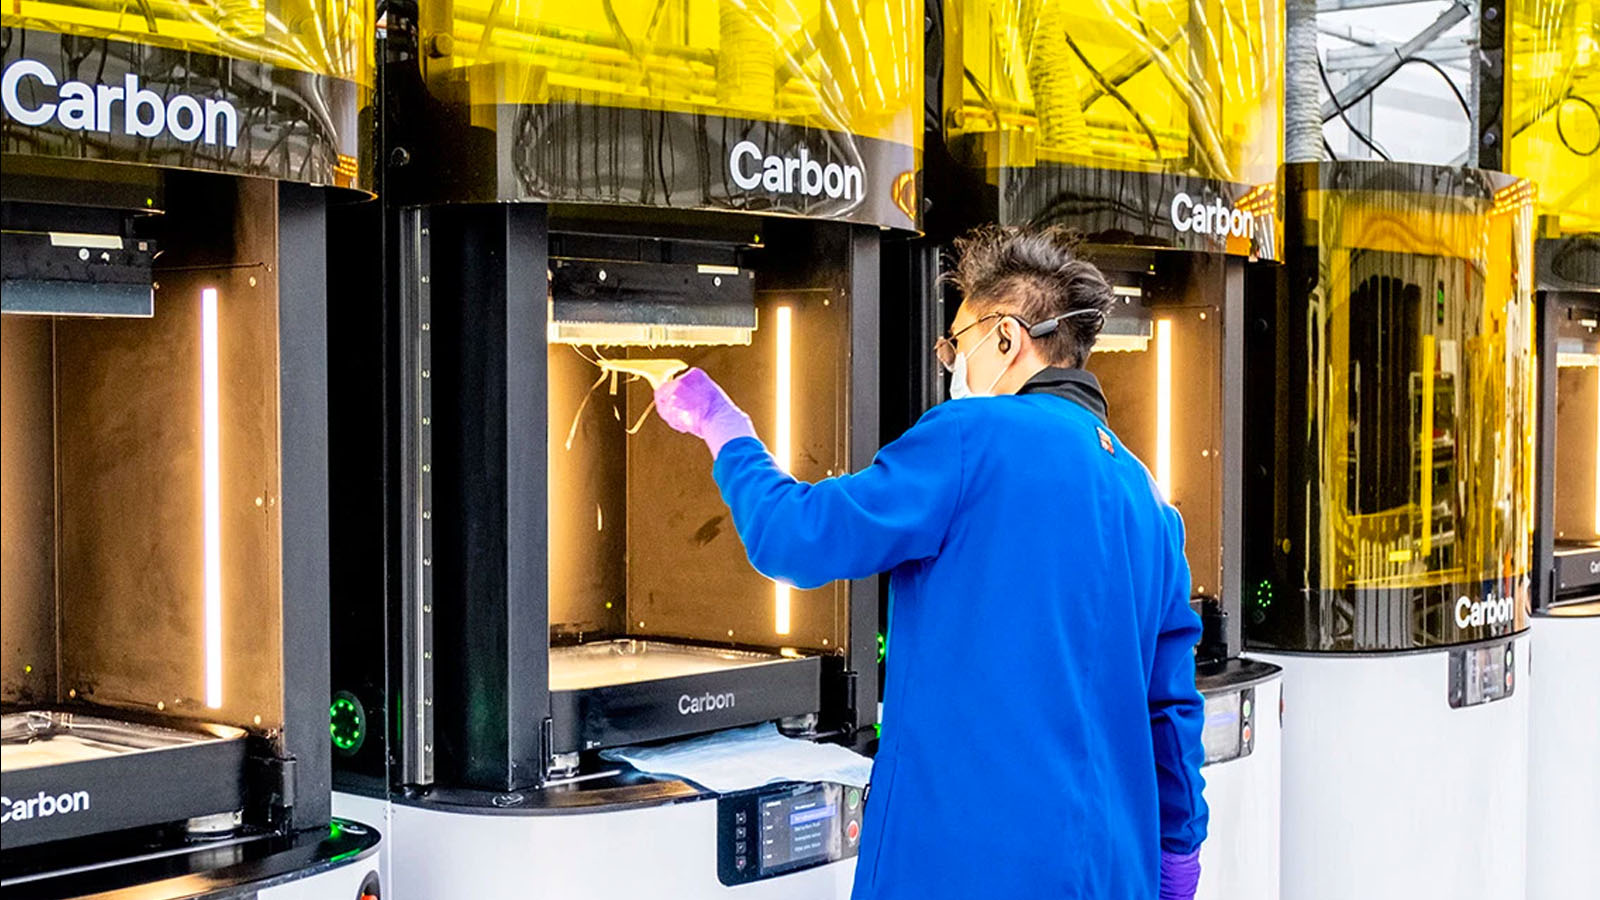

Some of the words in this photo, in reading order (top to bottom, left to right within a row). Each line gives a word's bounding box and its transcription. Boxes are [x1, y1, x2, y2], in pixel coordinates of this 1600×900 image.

[1, 59, 237, 147] Carbon
[730, 141, 863, 201] Carbon
[1171, 192, 1254, 239] Carbon
[1455, 593, 1513, 629] Carbon
[678, 692, 735, 715] Carbon
